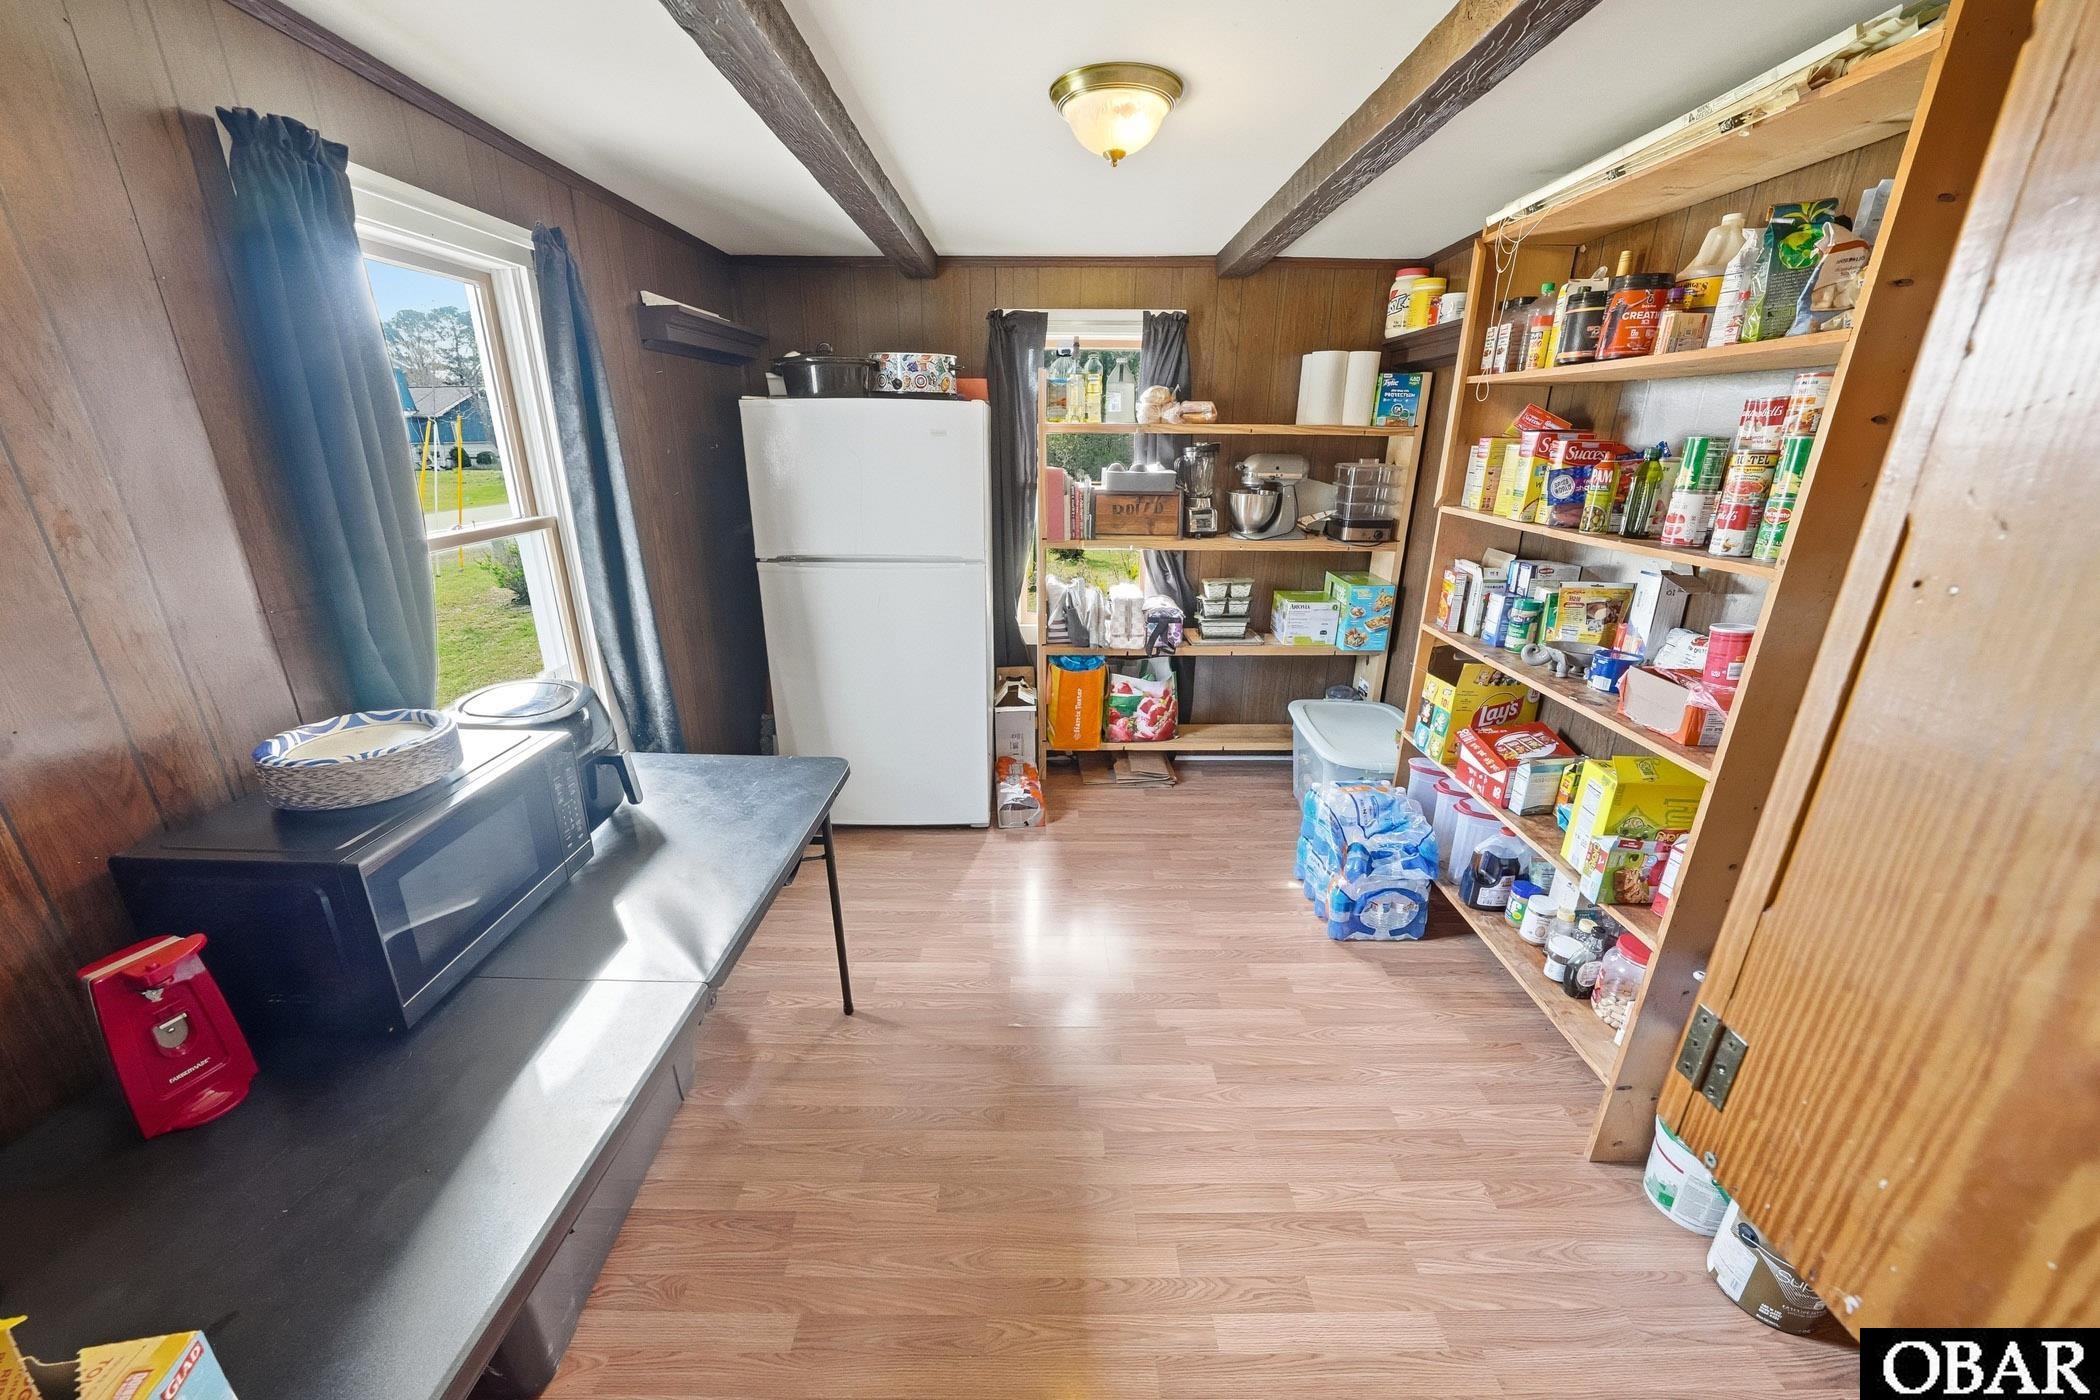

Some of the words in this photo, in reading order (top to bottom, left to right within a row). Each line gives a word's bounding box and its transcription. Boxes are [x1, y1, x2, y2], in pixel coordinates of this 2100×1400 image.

[1621, 311, 1659, 320] CREATI
[1565, 446, 1608, 461] Succes
[1591, 468, 1613, 483] PAM
[1478, 700, 1519, 728] Lay's
[164, 1343, 202, 1398] GLAD
